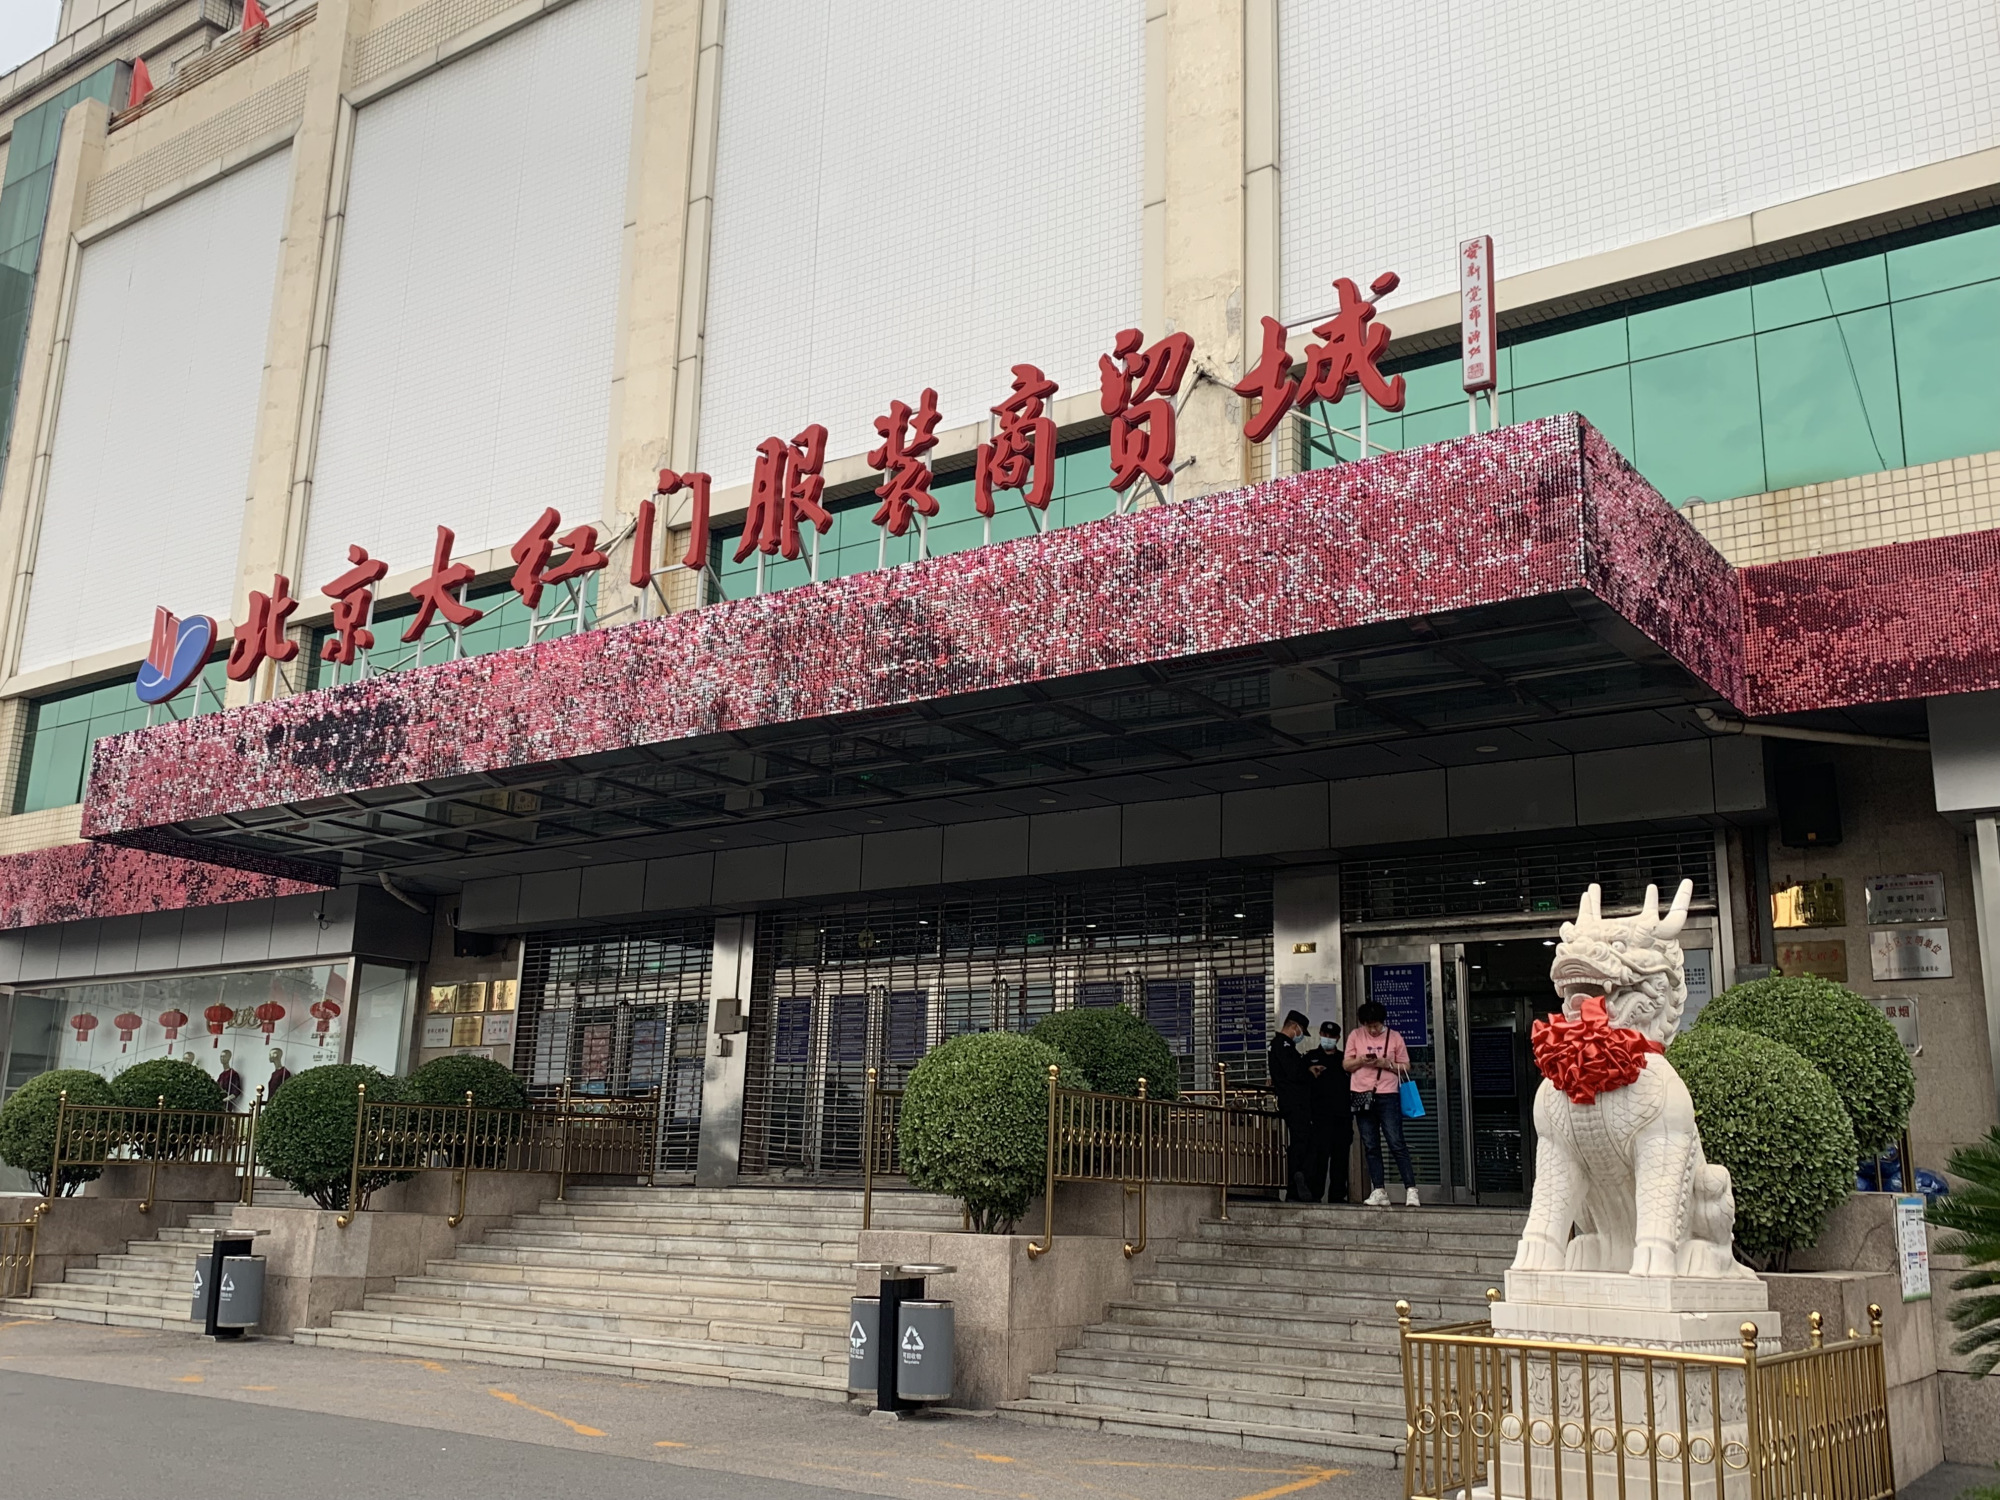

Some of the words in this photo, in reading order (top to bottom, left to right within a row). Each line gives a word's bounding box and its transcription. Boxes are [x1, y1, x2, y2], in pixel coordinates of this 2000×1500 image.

[226, 271, 1405, 682] 北京大红门服装商贸城
[1887, 894, 1924, 903] 营业时间
[1878, 935, 1942, 958] 丰台区文明单位
[1879, 1005, 1910, 1018] 吸烟
